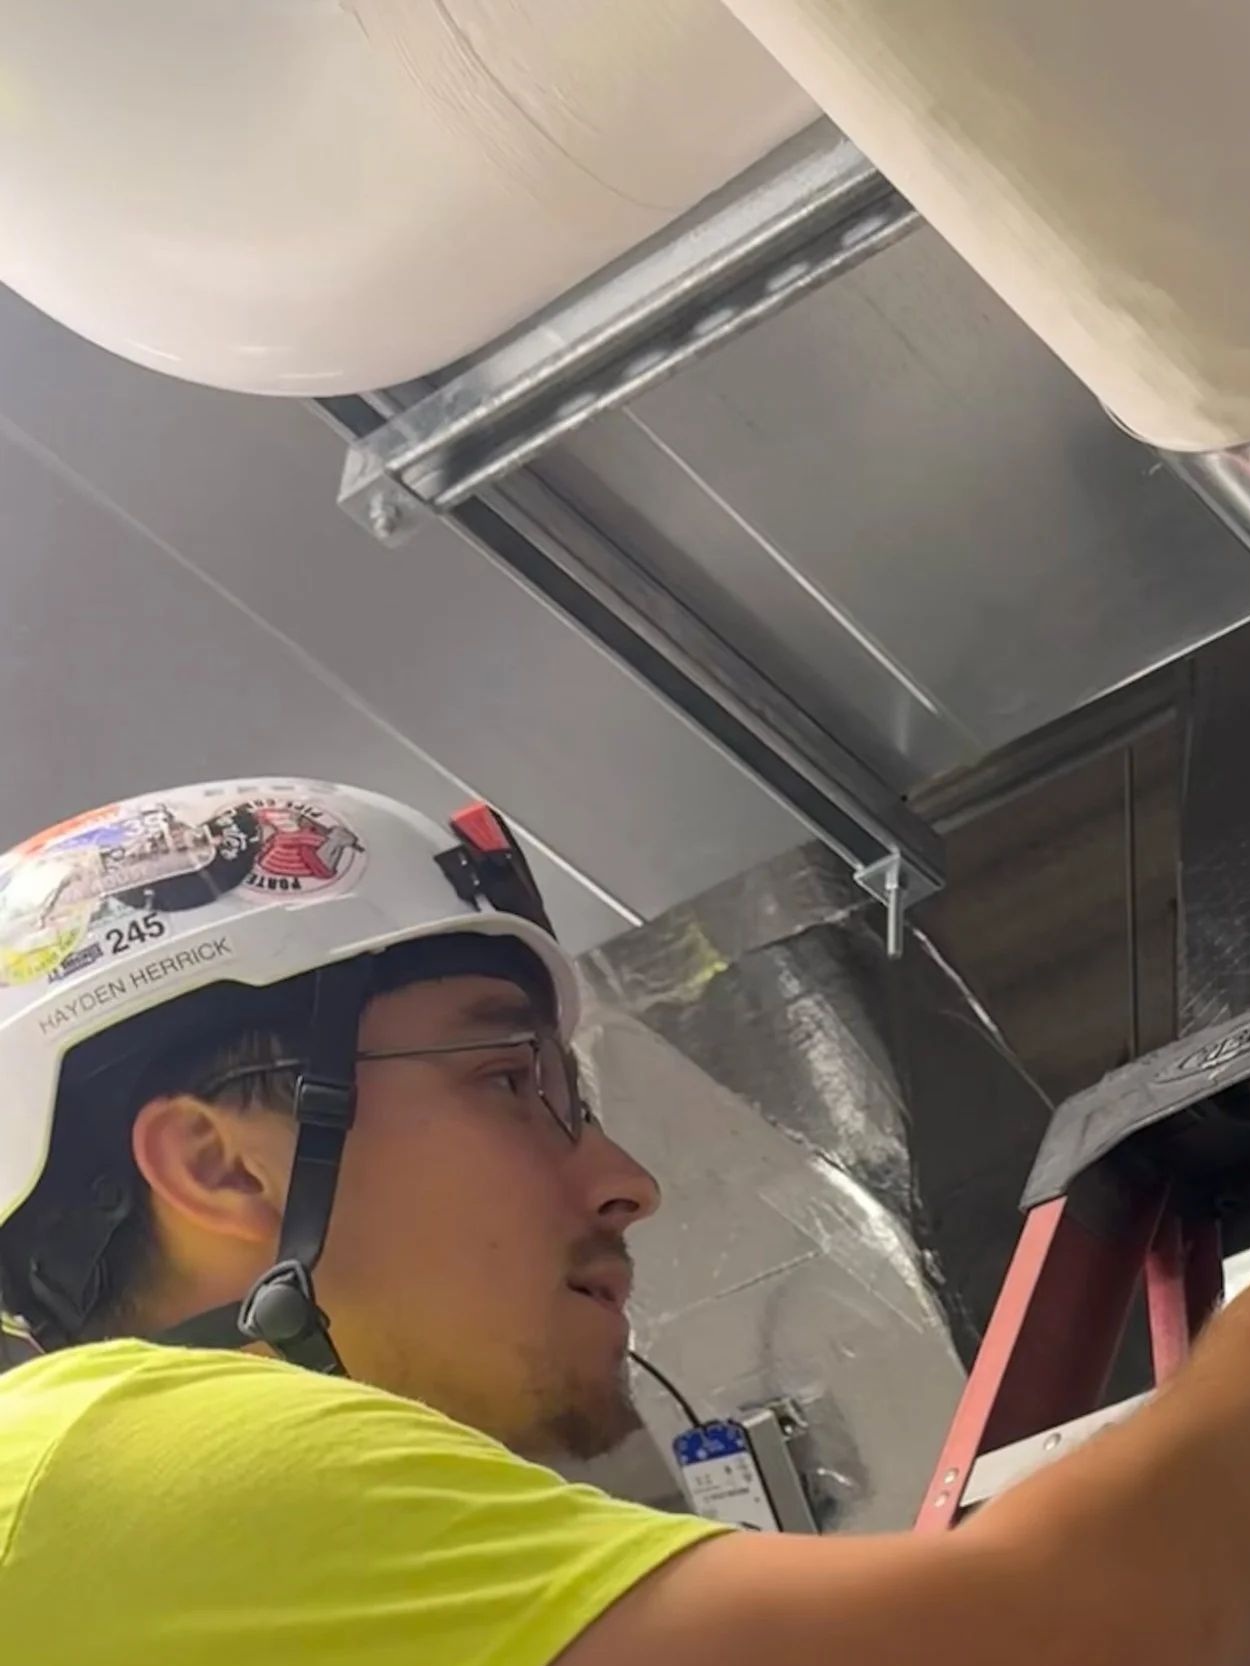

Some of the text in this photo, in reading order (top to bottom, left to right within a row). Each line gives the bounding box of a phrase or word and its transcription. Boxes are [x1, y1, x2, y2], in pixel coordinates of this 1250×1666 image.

[106, 912, 165, 954] 245
[38, 978, 126, 1034] HAYDEN
[129, 937, 232, 988] HERRICK
